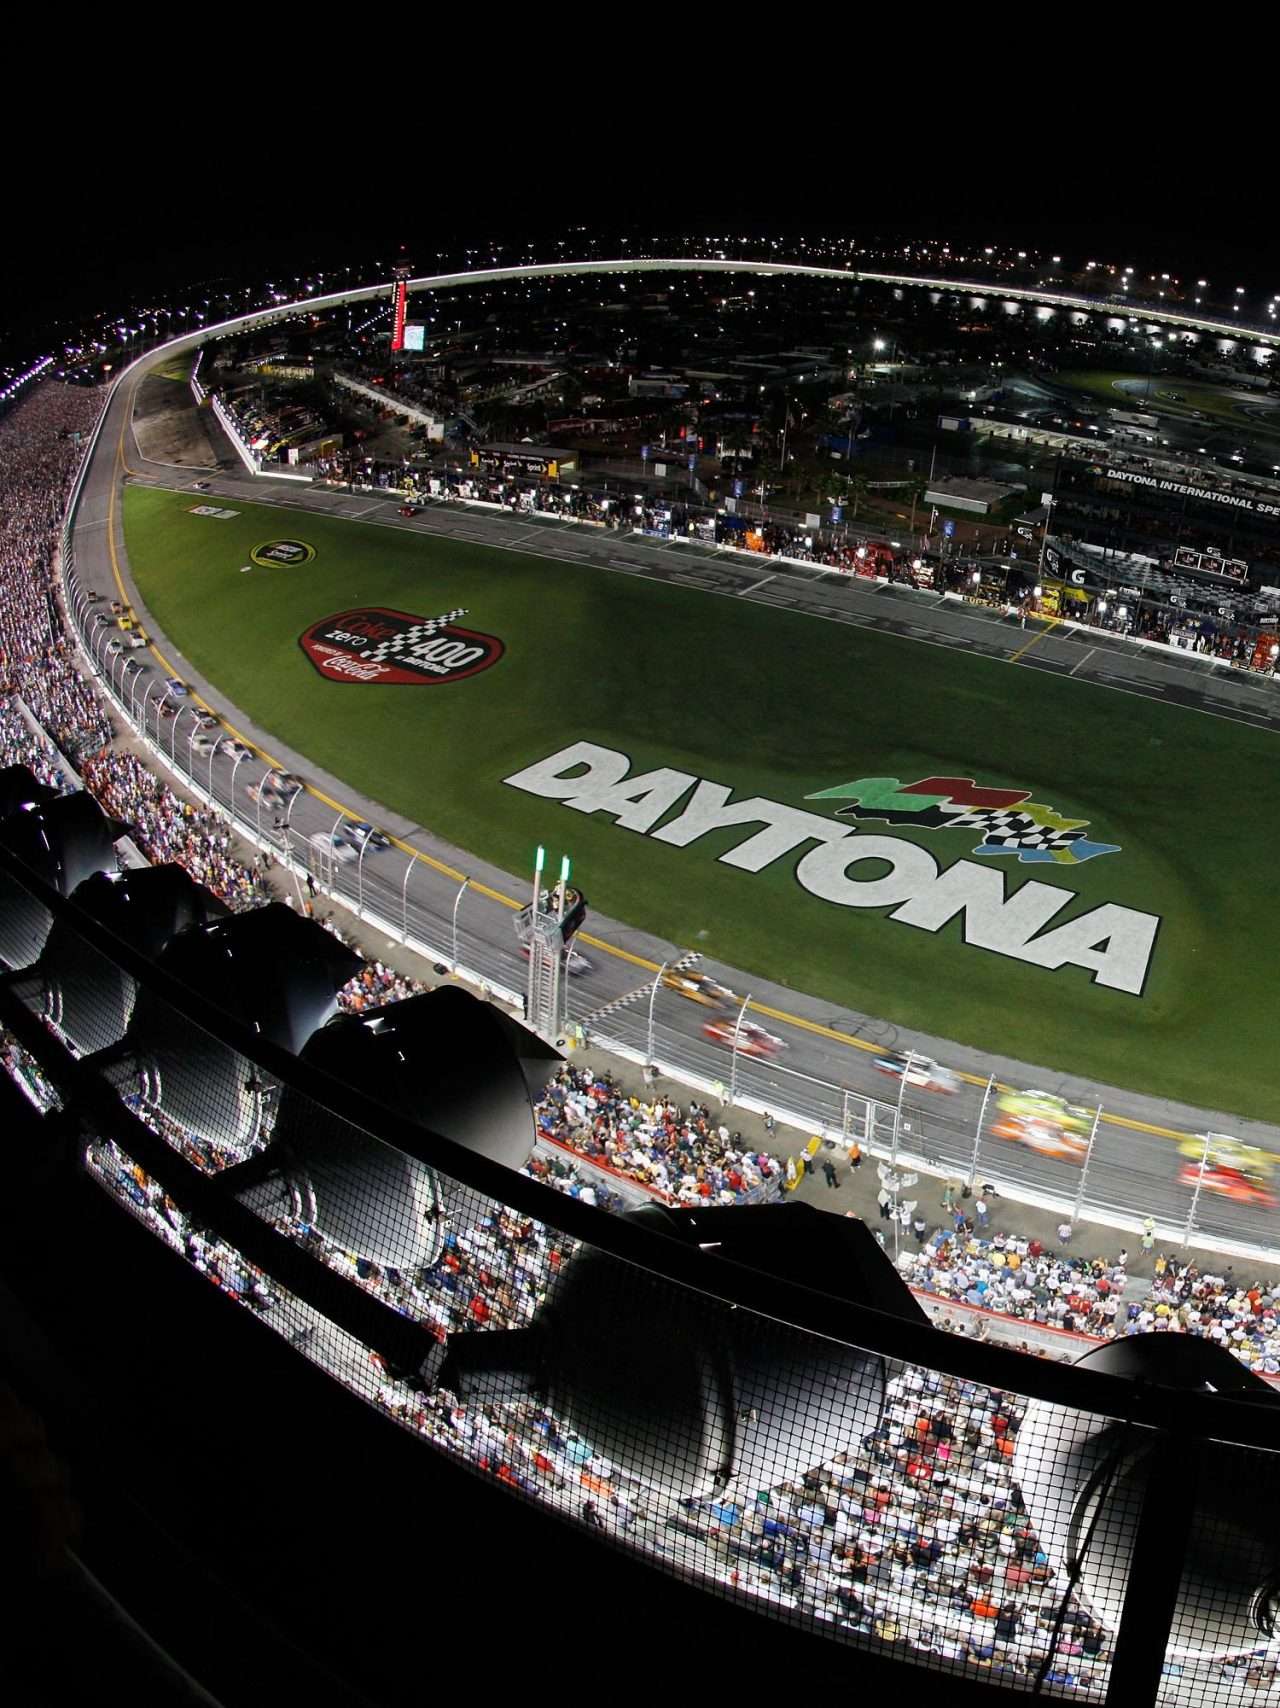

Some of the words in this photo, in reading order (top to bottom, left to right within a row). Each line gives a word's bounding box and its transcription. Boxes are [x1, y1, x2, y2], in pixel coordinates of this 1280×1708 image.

[527, 463, 541, 471] Sprint
[1107, 469, 1157, 488] DAYTONA
[1159, 481, 1254, 510] INTERNATIONAL
[1072, 570, 1086, 584] G
[325, 629, 368, 646] zero
[336, 615, 398, 640] Coke
[410, 637, 485, 668] 400
[503, 740, 1161, 995] DAYTONA
